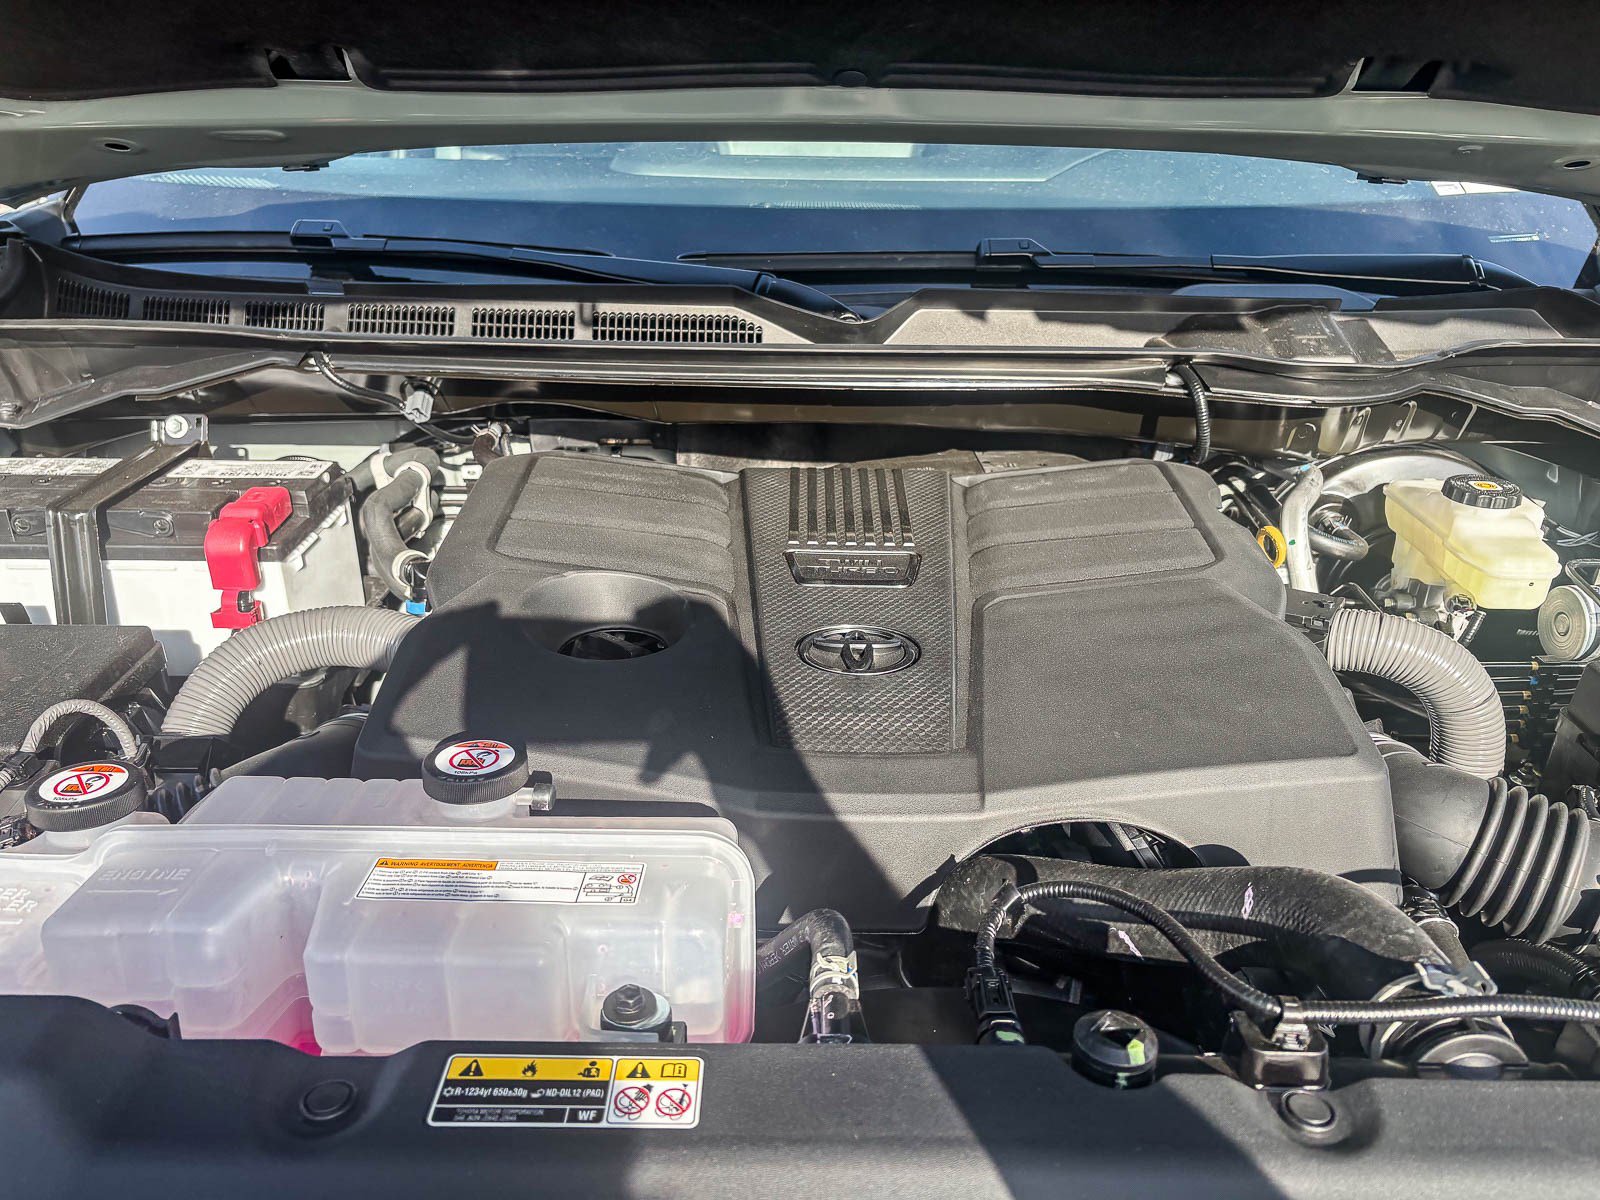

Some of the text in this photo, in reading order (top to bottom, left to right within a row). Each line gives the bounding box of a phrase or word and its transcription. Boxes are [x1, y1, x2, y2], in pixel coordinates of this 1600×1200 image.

[454, 1086, 492, 1098] R-1234yf
[582, 1088, 605, 1099] (PAG)
[577, 1110, 598, 1121] WF
